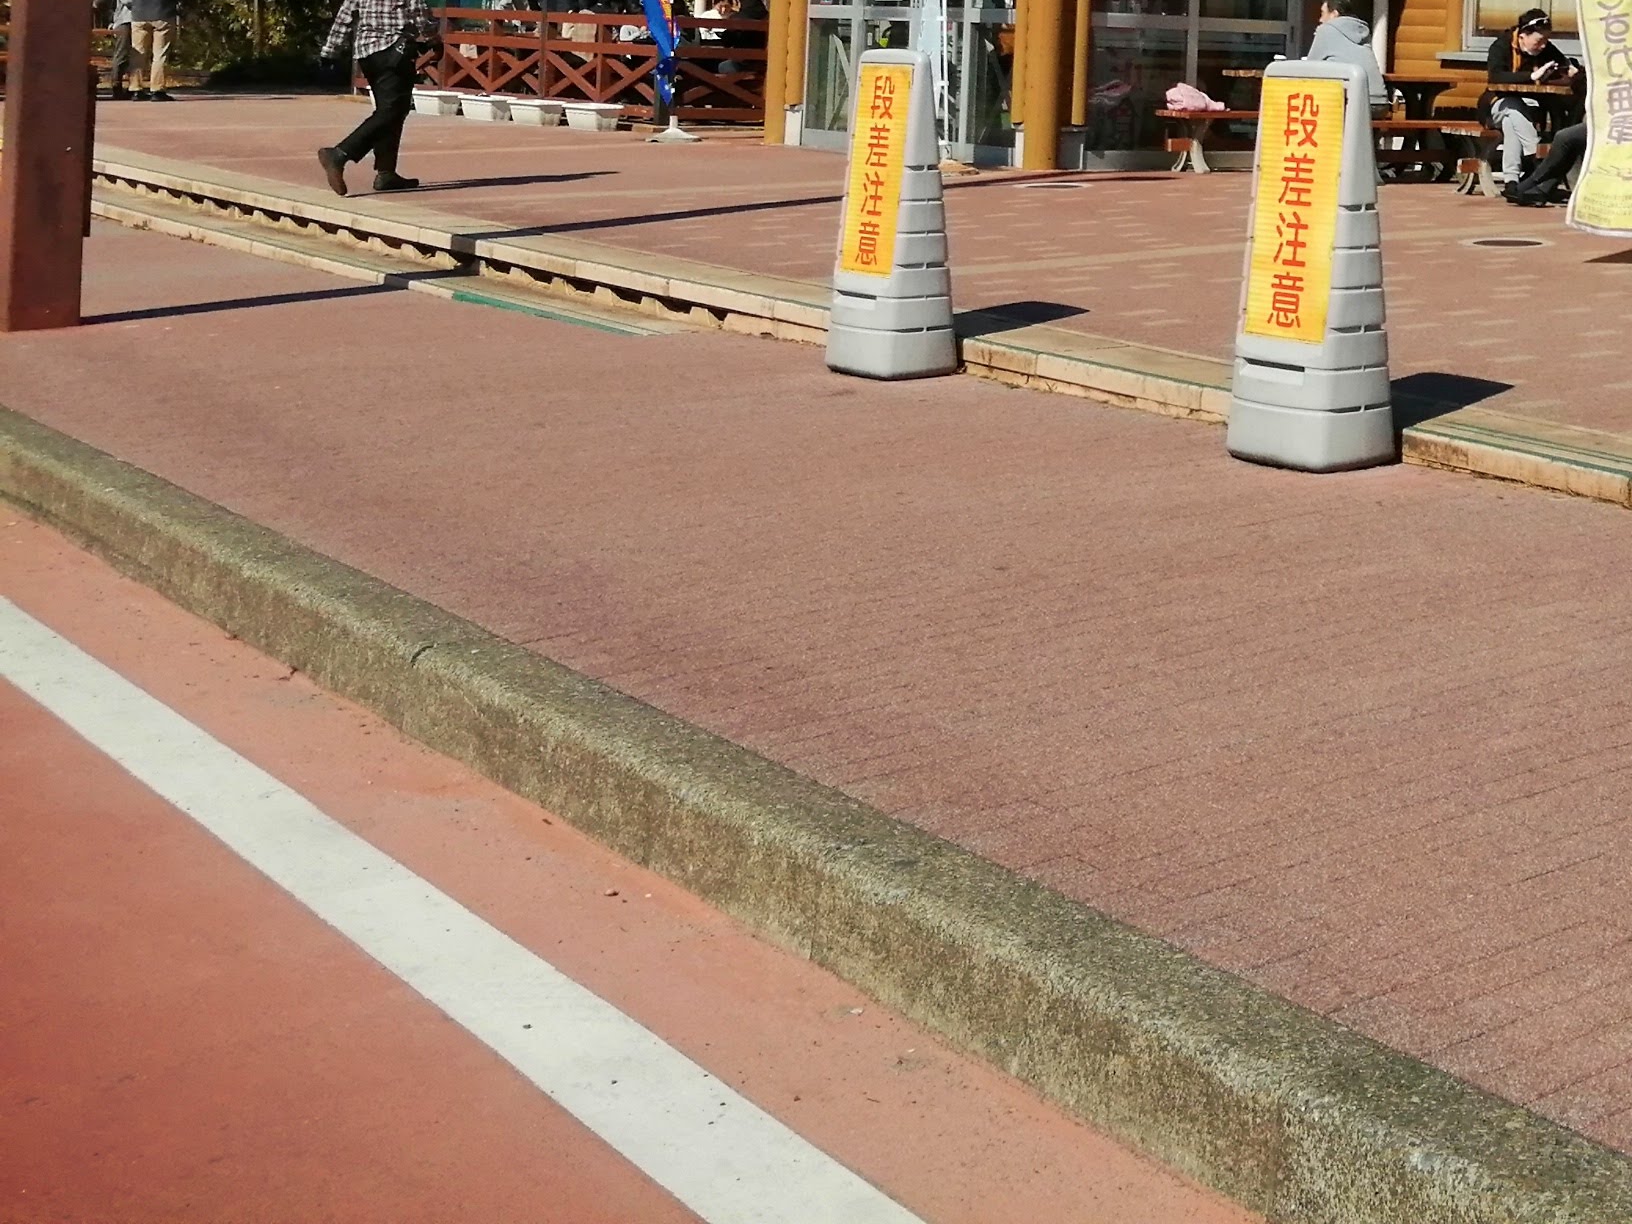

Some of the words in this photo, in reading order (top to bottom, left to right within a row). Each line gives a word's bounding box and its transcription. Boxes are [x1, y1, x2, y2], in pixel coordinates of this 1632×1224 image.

[855, 74, 895, 267] 段差注意
[1267, 92, 1320, 329] 段差注意
